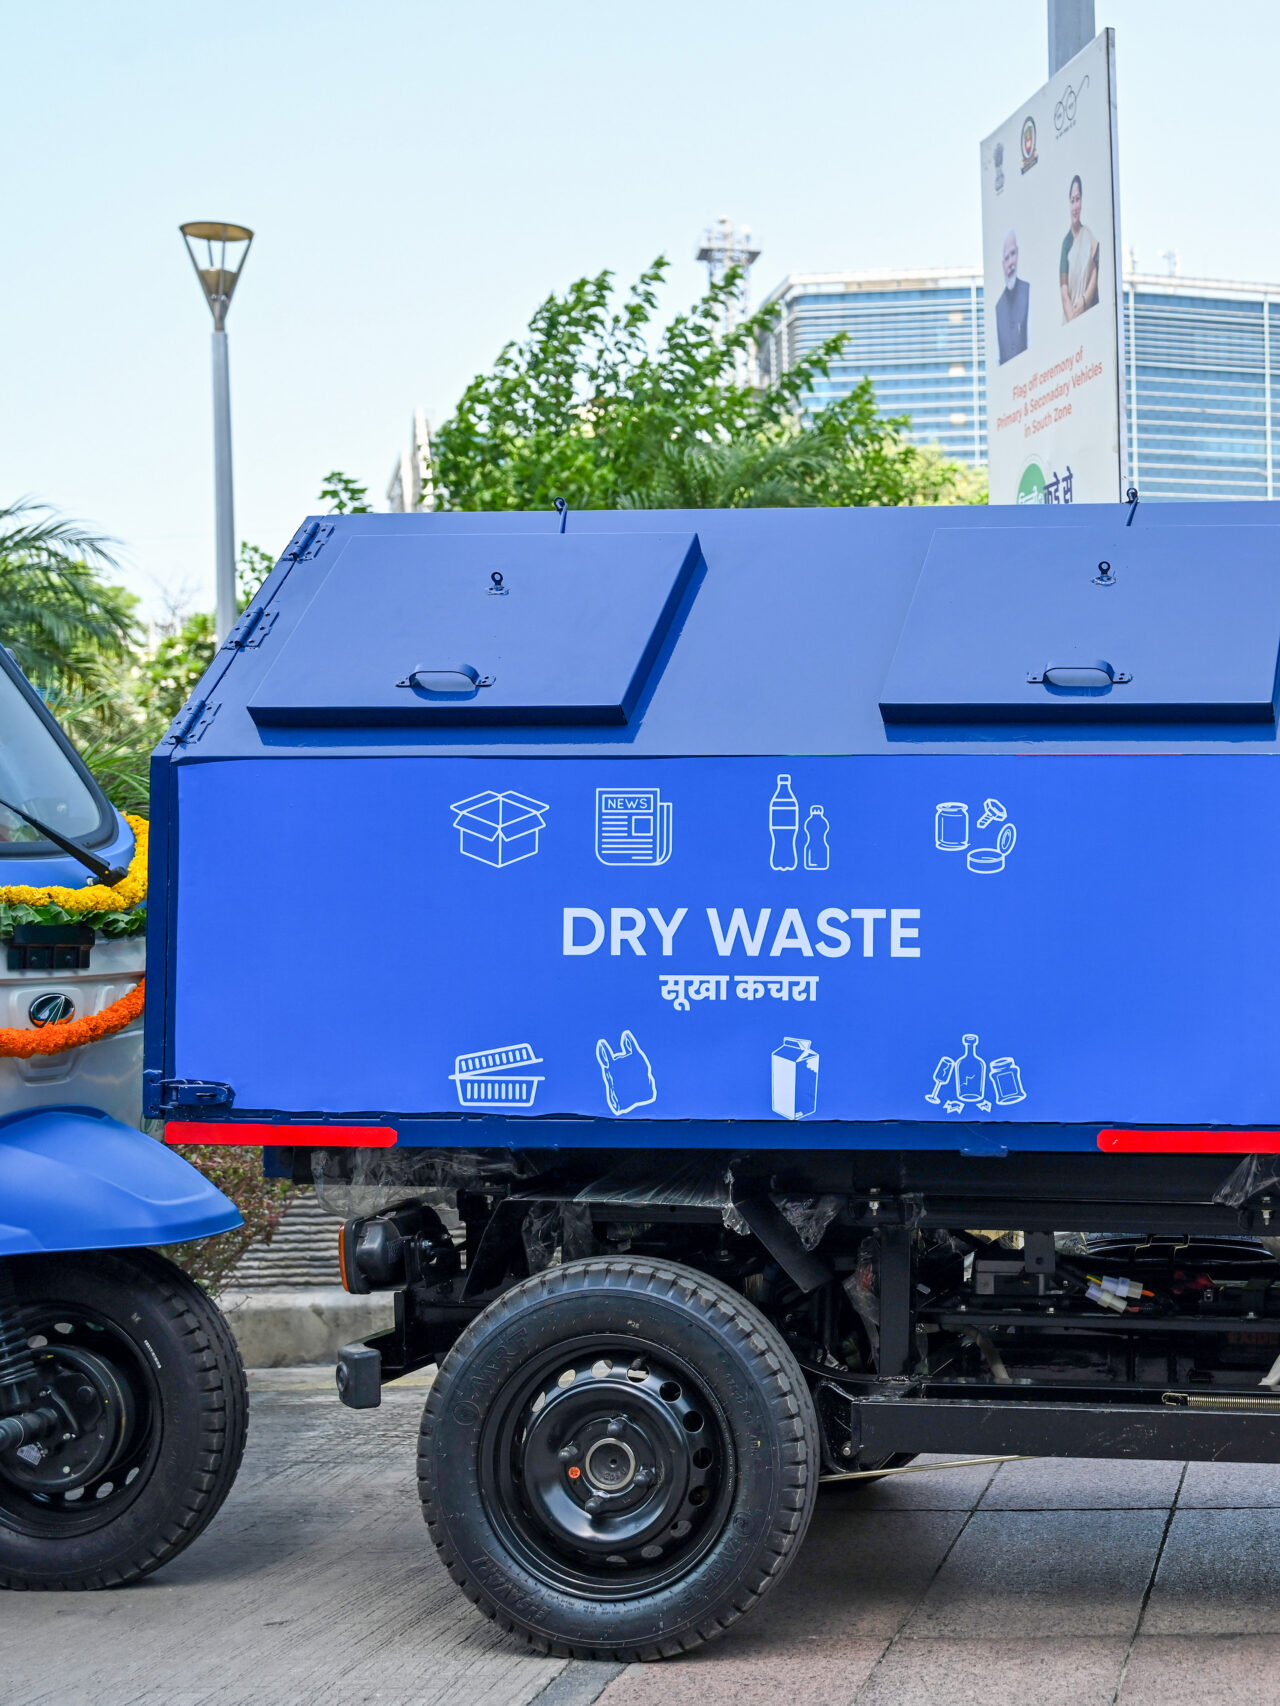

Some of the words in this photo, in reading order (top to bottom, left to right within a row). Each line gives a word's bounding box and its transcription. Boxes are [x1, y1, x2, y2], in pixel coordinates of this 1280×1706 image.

[1012, 383, 1028, 400] Flag
[1028, 372, 1039, 392] off
[1039, 354, 1075, 385] ceremony
[1075, 344, 1084, 363] of
[996, 408, 1022, 432] Primary
[1071, 361, 1103, 389] Vehicles
[1032, 412, 1053, 435] South
[1053, 403, 1073, 423] Zone
[607, 798, 648, 809] NEWS
[562, 906, 690, 957] DRY
[705, 906, 922, 959] WASTE
[658, 973, 730, 1012] सूखा
[733, 974, 820, 1002] कचरा
